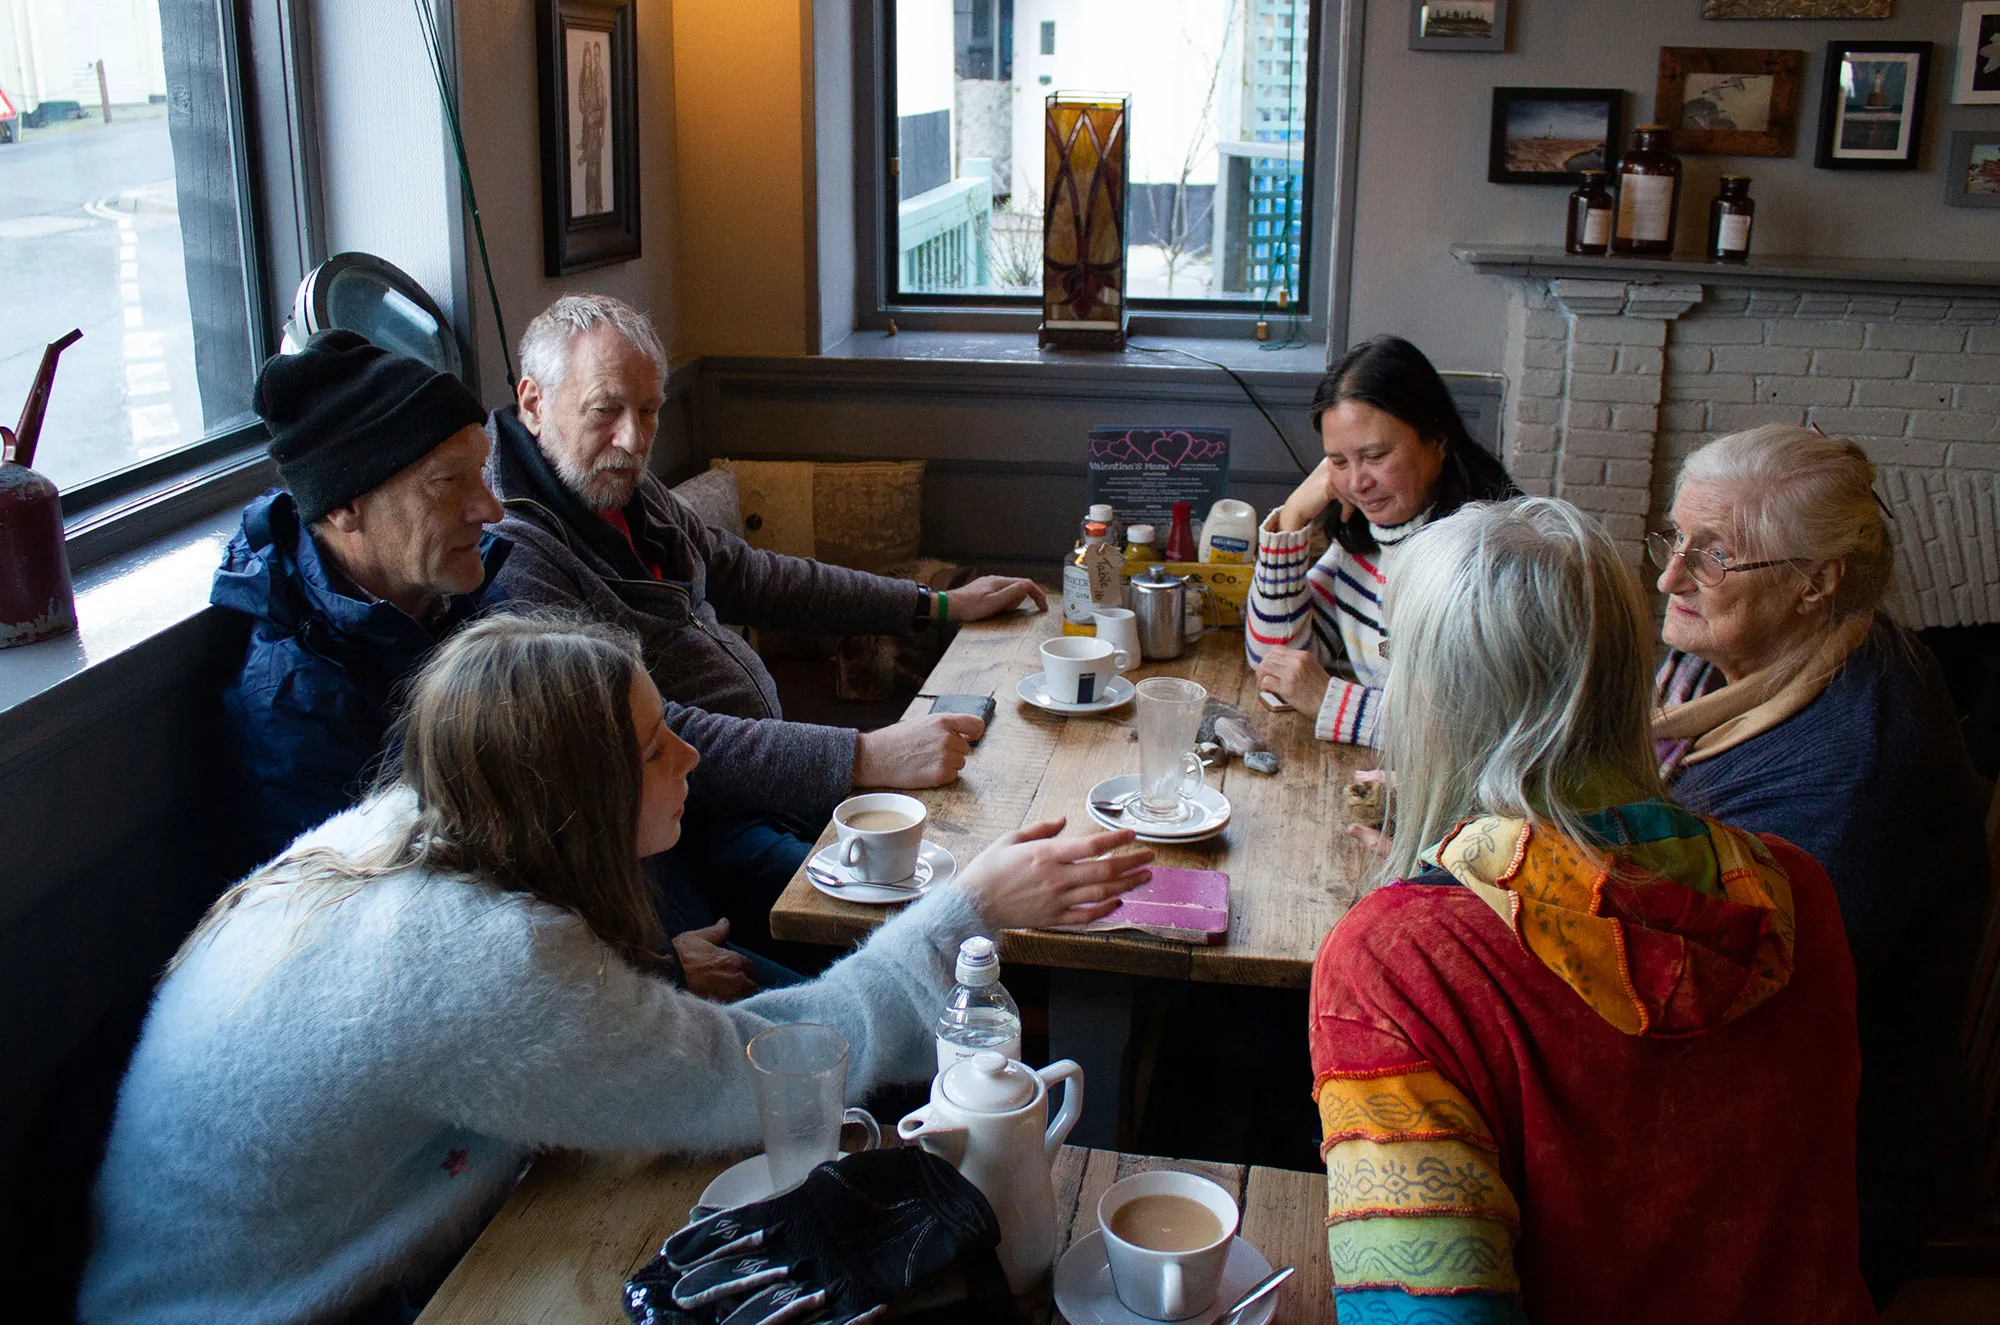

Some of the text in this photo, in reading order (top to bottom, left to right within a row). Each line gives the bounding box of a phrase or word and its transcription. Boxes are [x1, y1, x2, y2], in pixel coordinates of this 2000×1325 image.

[1144, 463, 1170, 471] Menu
[1096, 557, 1113, 589] Table
[1212, 572, 1242, 584] Co.
[1075, 591, 1089, 600] GIN
